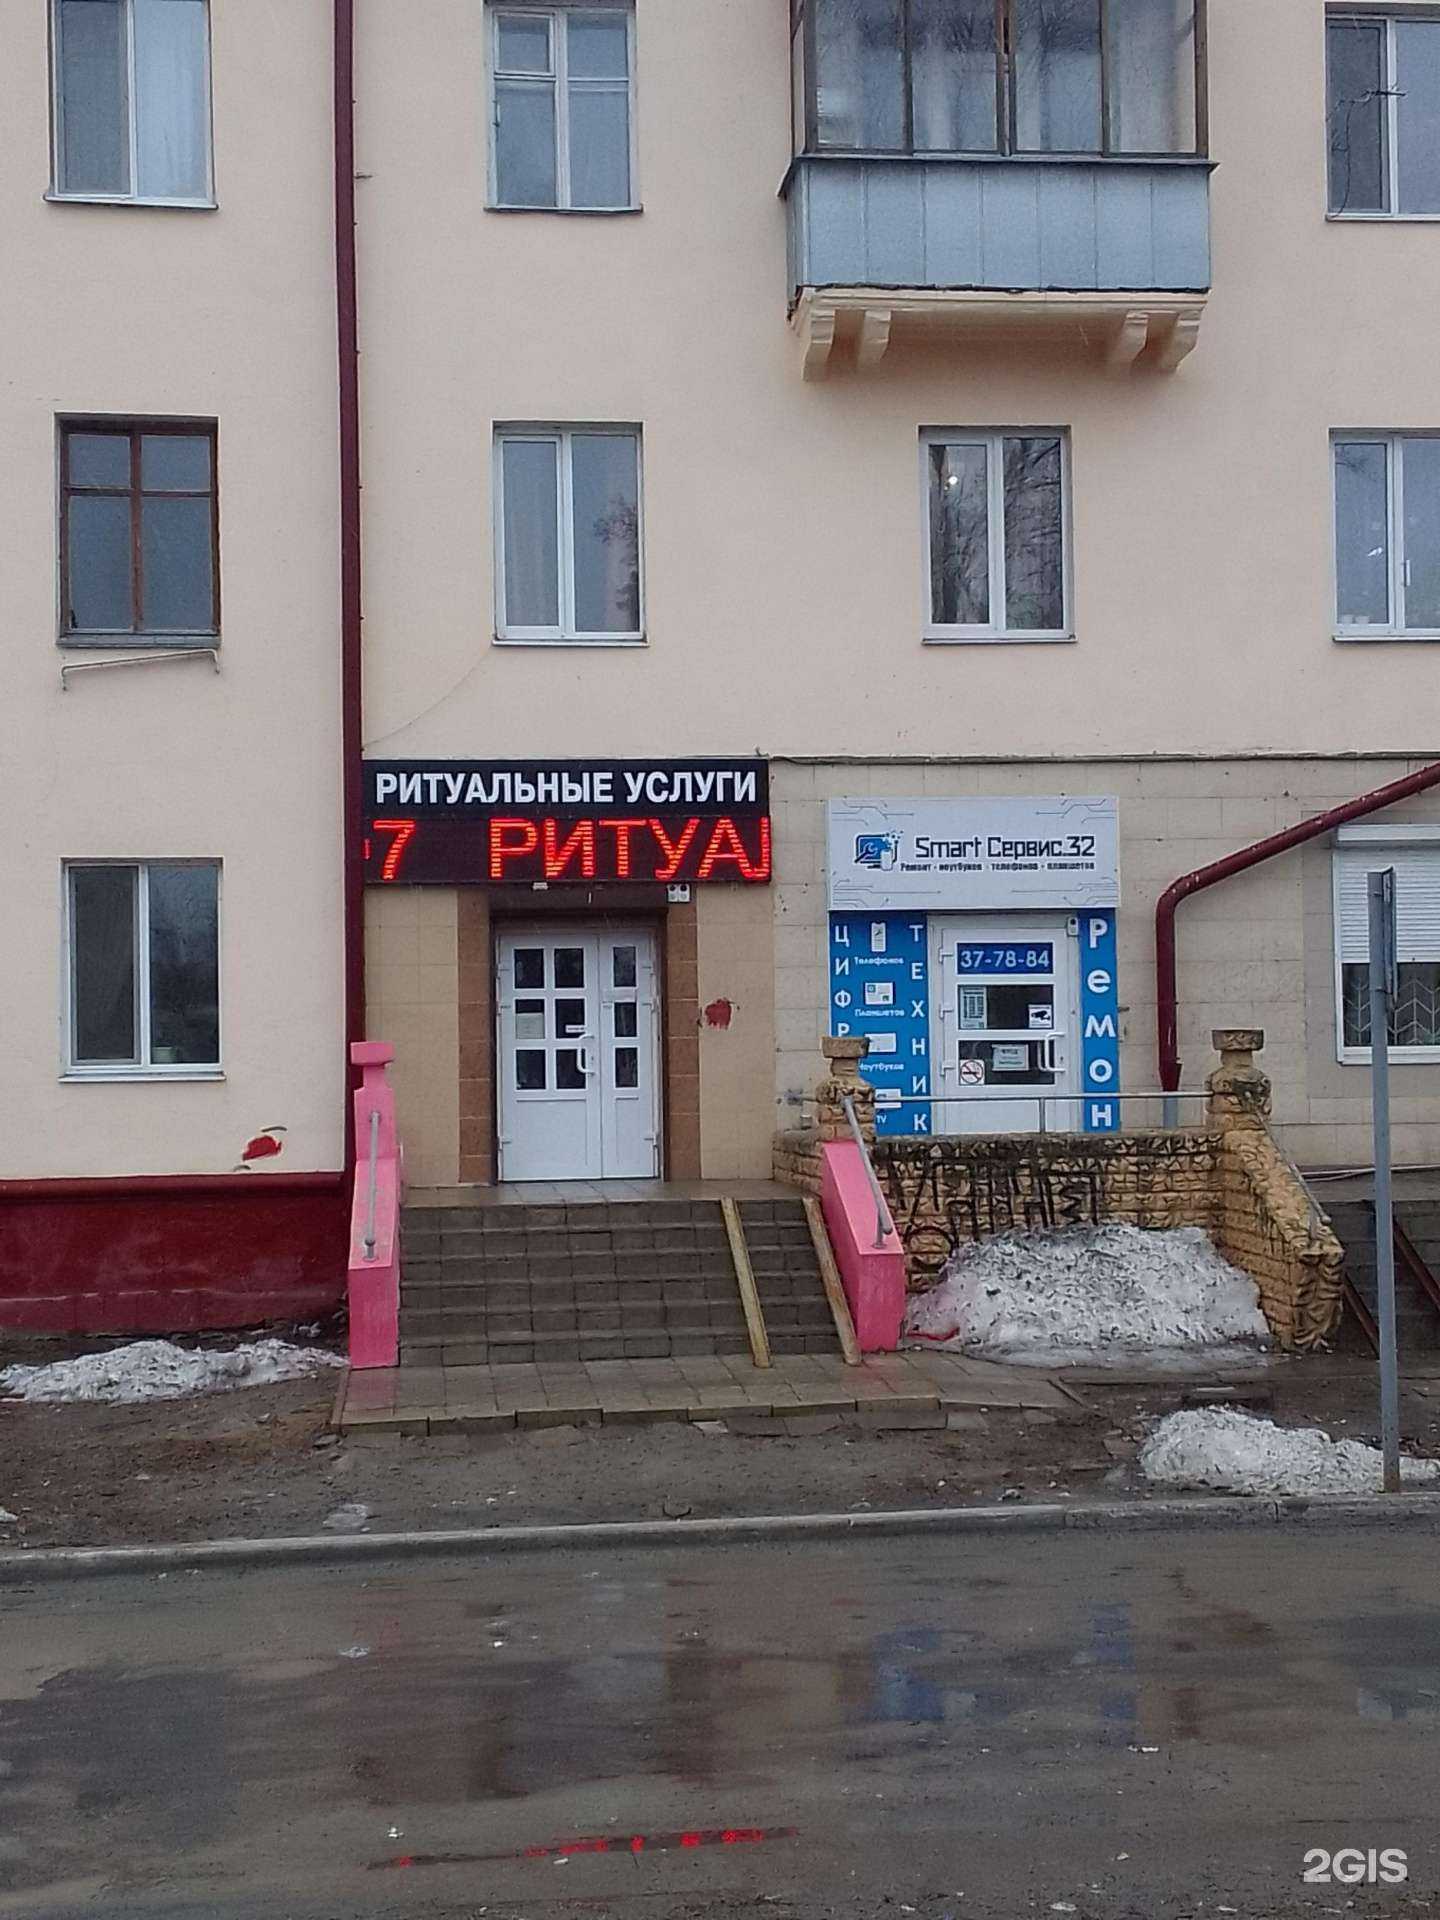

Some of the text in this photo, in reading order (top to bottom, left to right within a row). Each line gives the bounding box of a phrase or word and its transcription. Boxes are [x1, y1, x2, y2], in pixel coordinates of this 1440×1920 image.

[376, 772, 757, 803] РИТУАЛЬНЫЕ УСЛУГИ
[915, 836, 982, 858] Smart
[960, 951, 1050, 968] 37-78-84
